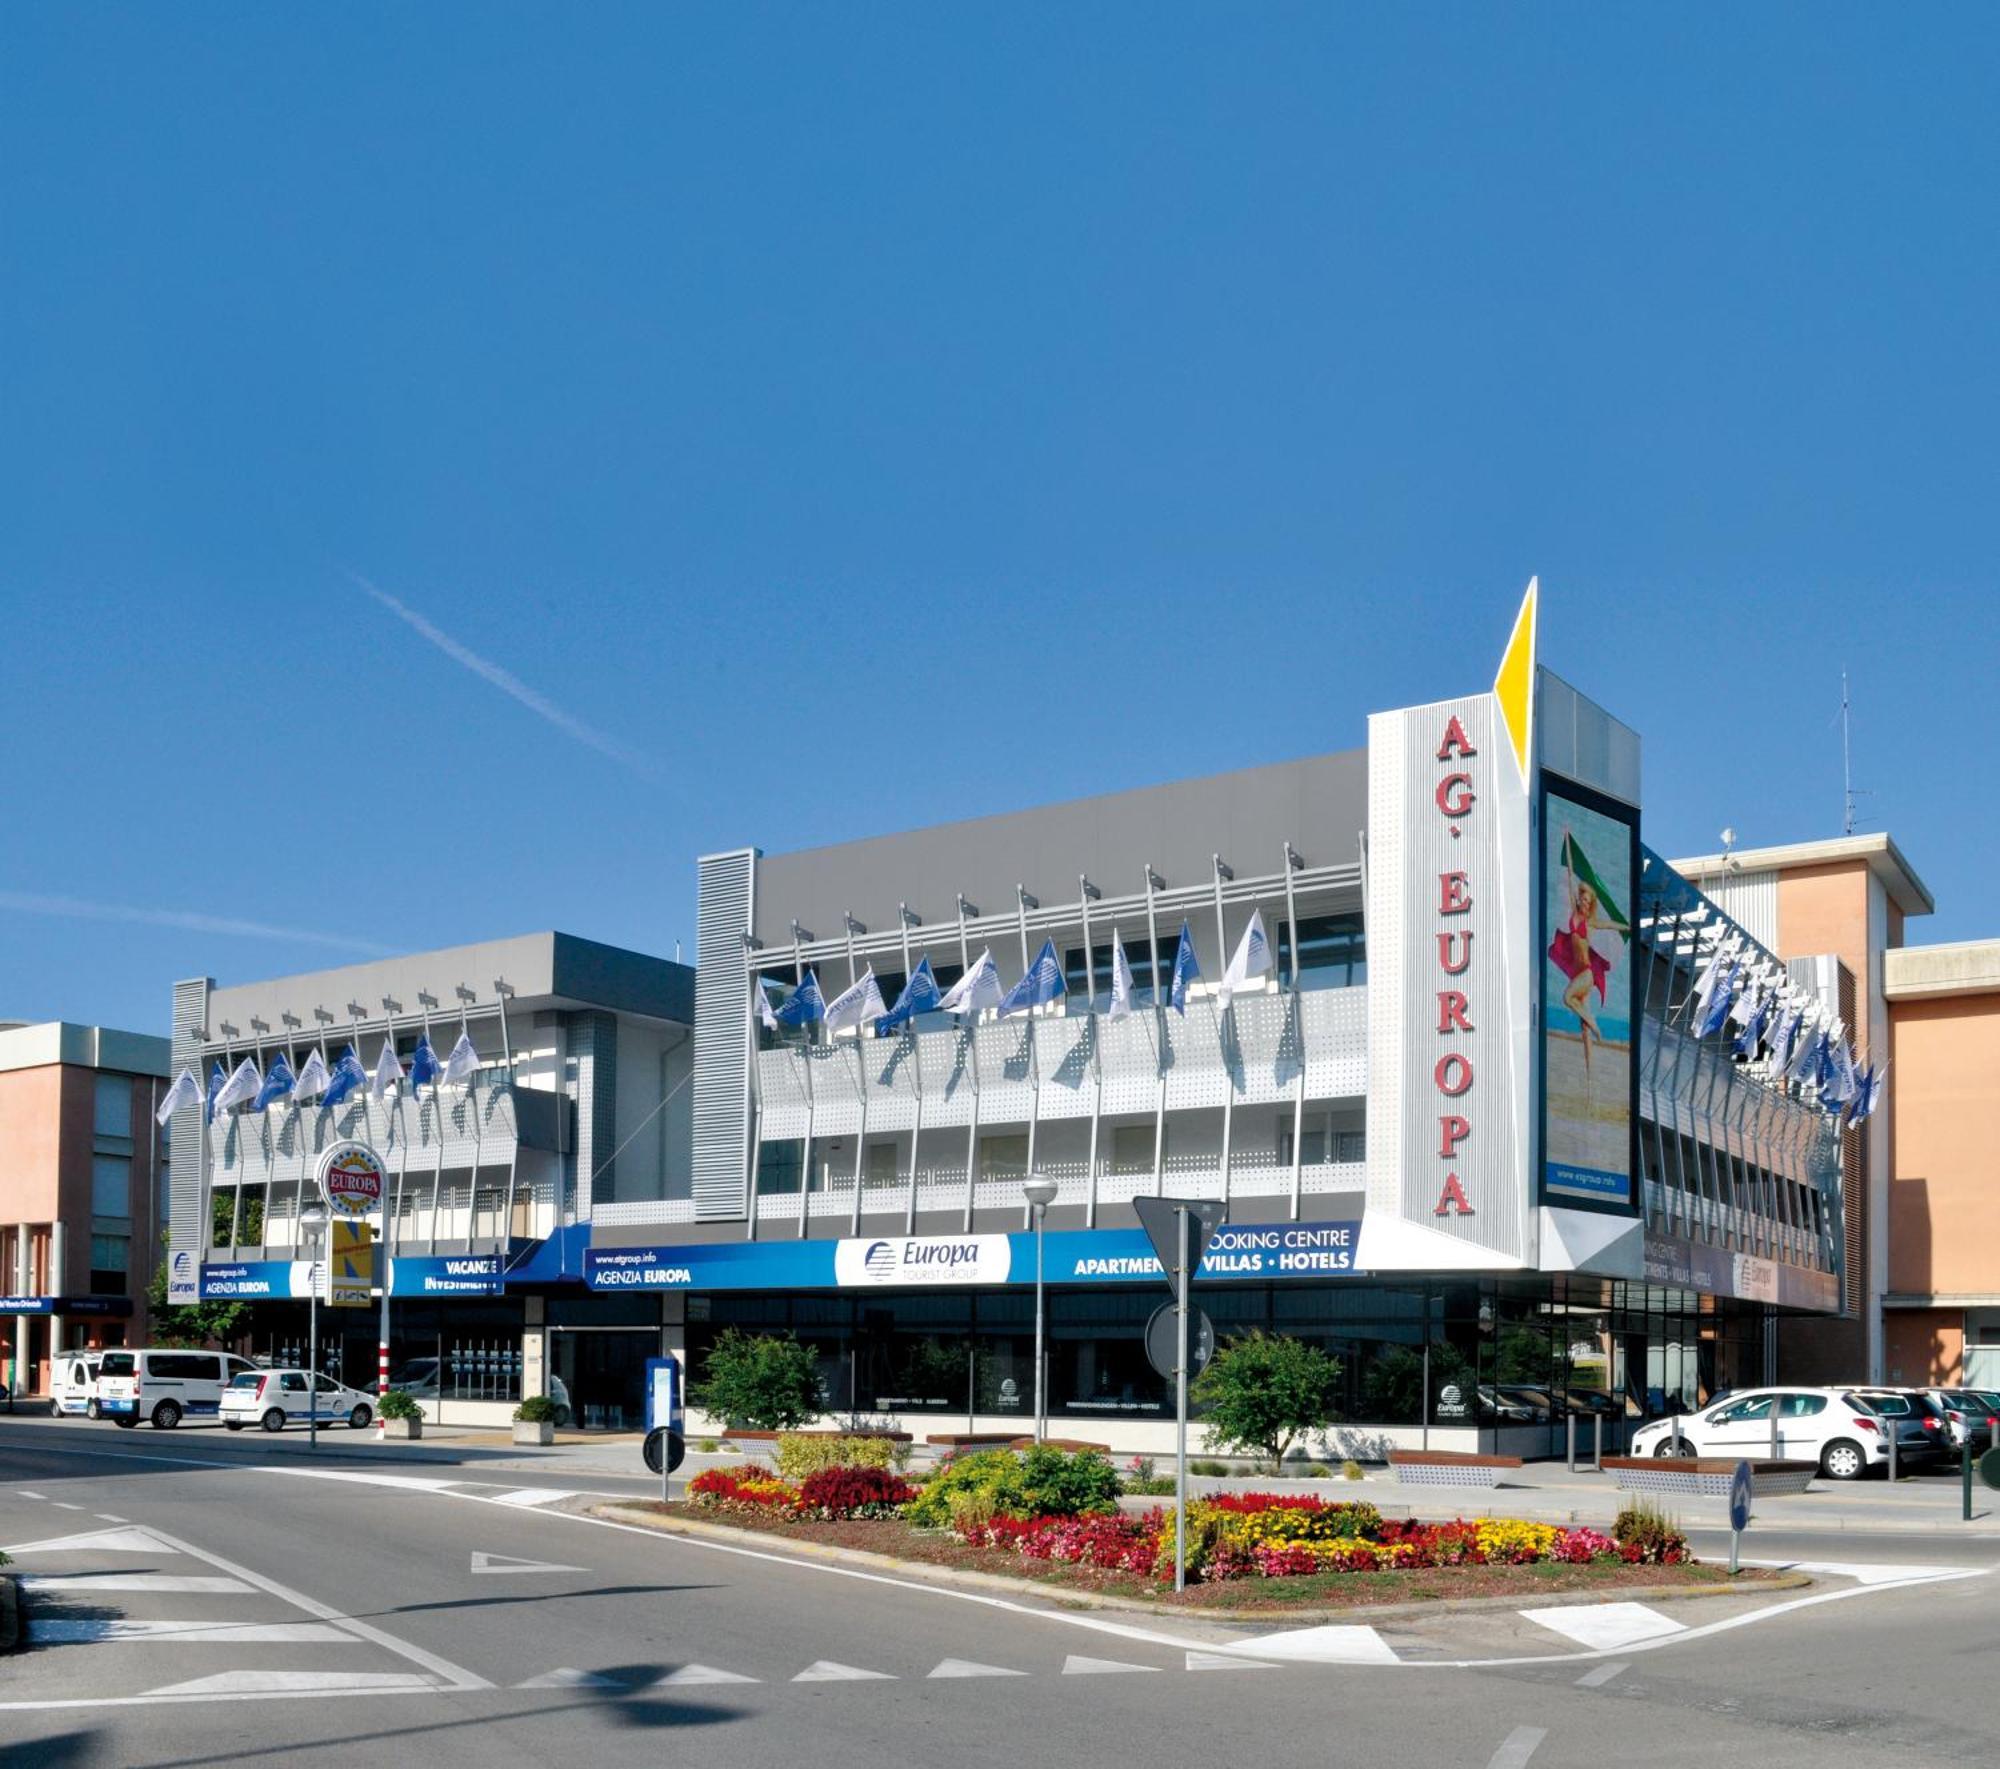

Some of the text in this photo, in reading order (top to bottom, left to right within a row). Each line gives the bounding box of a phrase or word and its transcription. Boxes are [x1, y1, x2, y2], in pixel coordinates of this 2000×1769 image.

[1434, 870, 1476, 1217] EUROPA
[330, 1173, 379, 1193] EUROPA
[1209, 1230, 1349, 1250] OOKING CENTRE
[903, 1242, 979, 1267] Europa
[1074, 1252, 1349, 1275] APARTMEN VILLAS HOTELS
[446, 1260, 497, 1275] VACANZE
[595, 1268, 692, 1285] AGENZIA EUROPA
[903, 1268, 978, 1281] TOURIST GROUP
[205, 1281, 270, 1294] AGENZIA EUROPA
